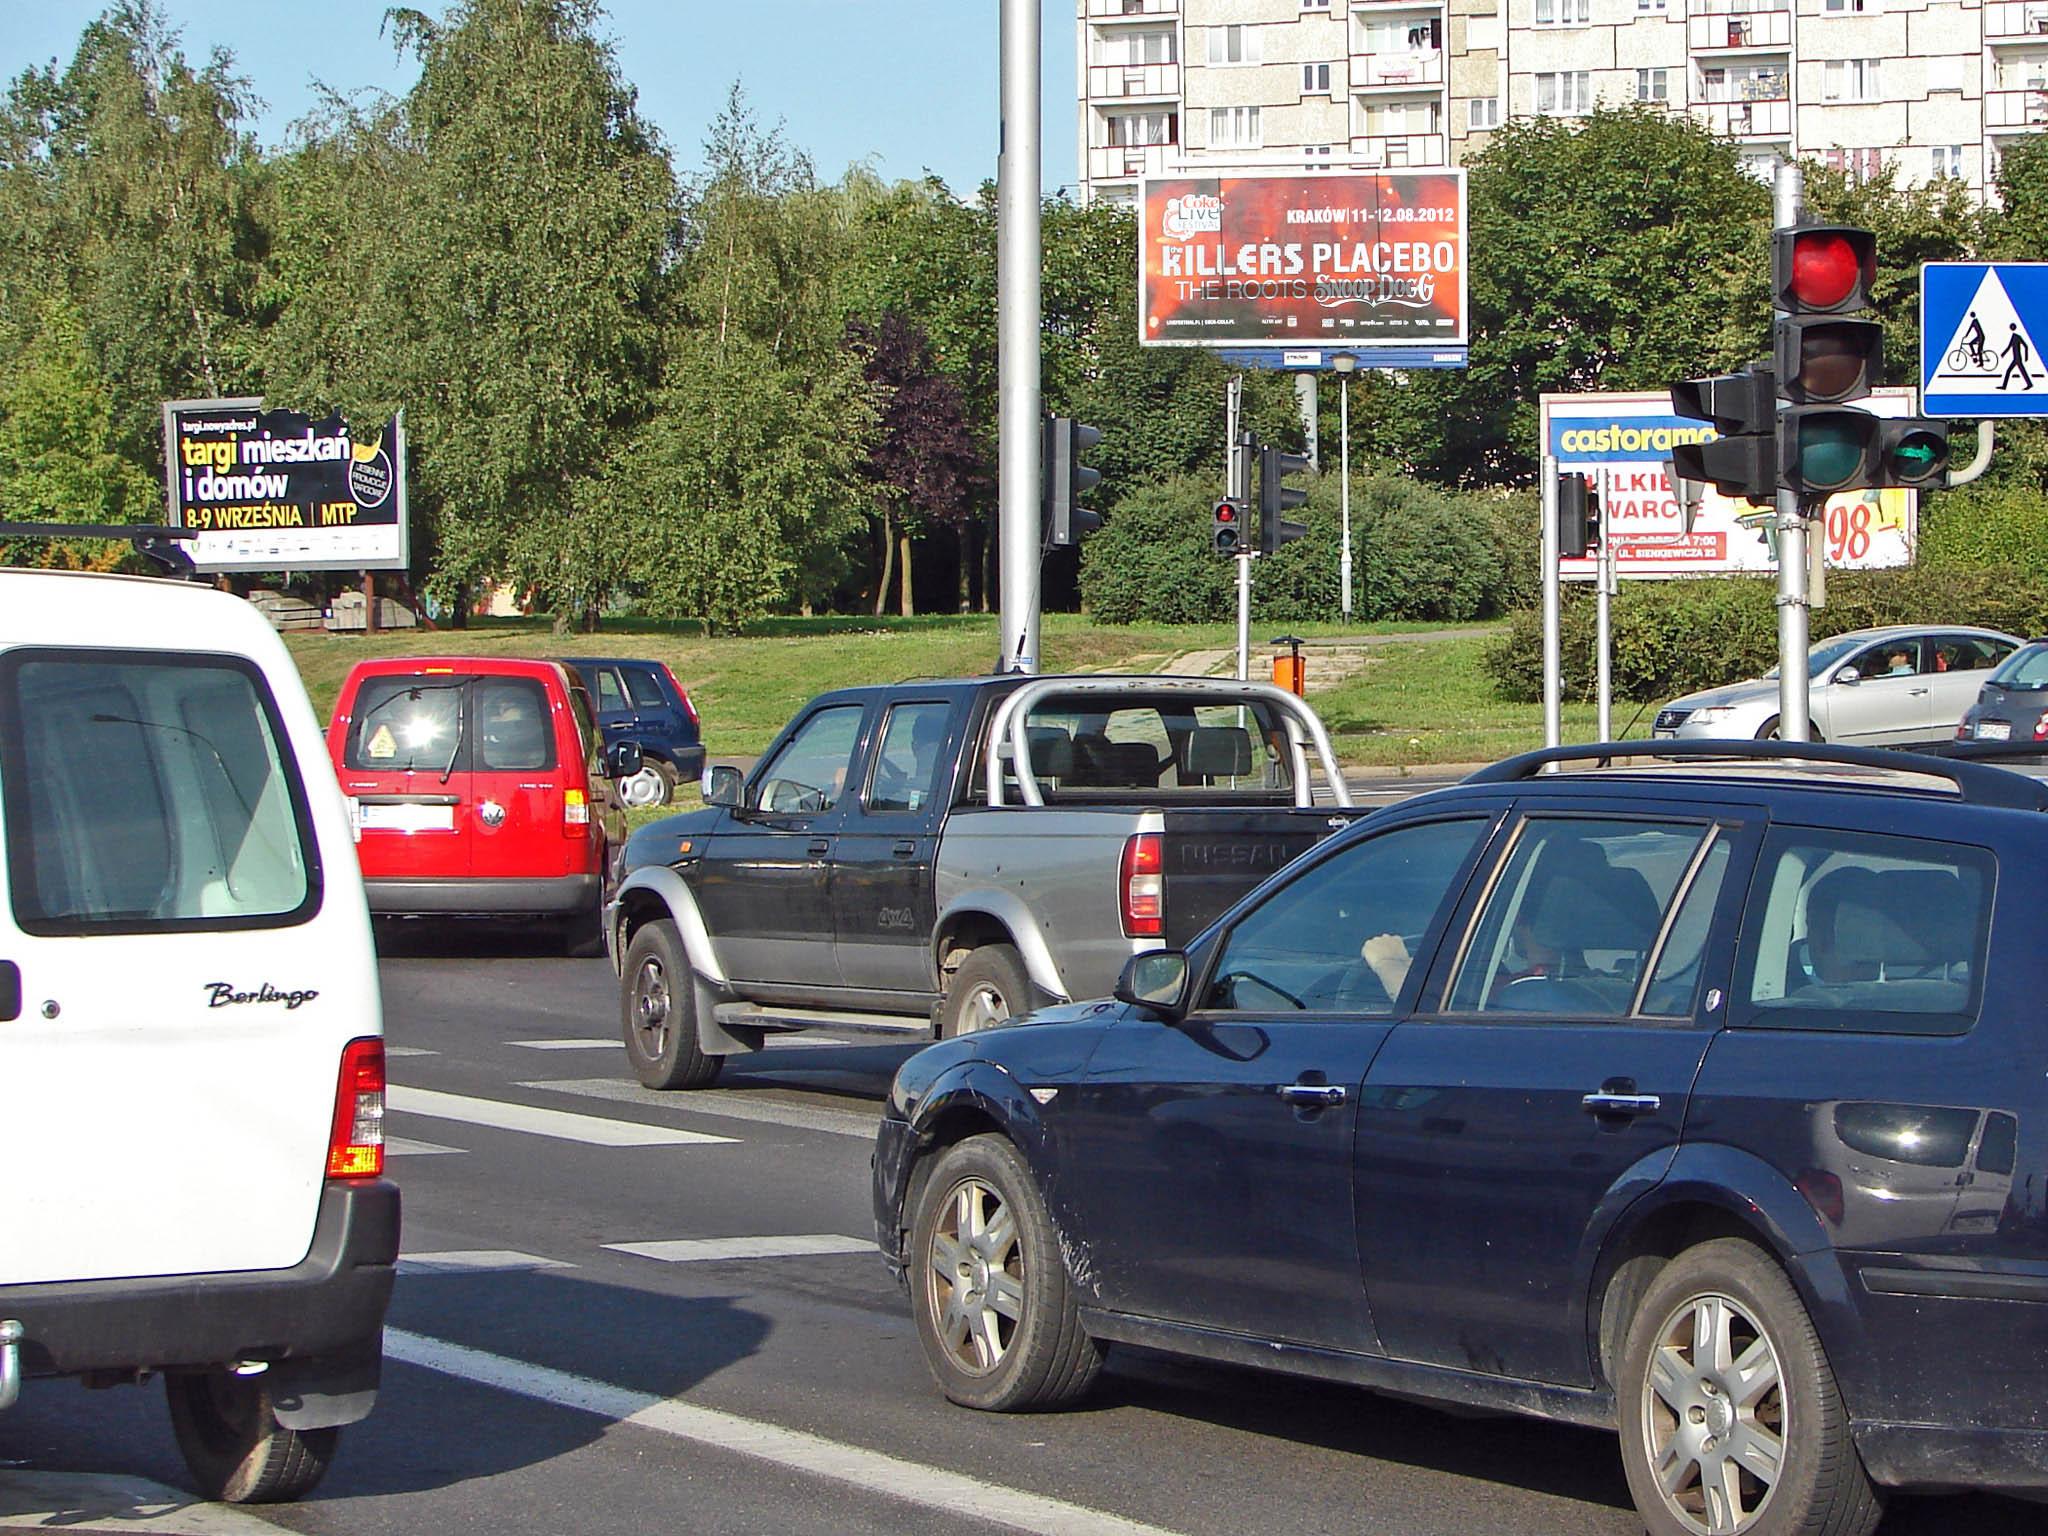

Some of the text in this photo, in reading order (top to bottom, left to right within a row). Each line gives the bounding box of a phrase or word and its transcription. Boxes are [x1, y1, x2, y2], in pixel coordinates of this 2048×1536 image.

[1179, 202, 1219, 220] Live
[1183, 196, 1219, 209] Coke
[1287, 206, 1454, 224] KRAKÓW 11-12.08.2012
[1162, 242, 1454, 276] KILLERS PLACEBO
[1175, 280, 1308, 300] THE ROOTS
[182, 427, 350, 474] targi mieszkań
[185, 465, 289, 501] i domów
[186, 501, 358, 529] 8-9 WRZEŚNIA MTP
[1693, 536, 1717, 546] 7:00
[203, 982, 319, 1010] Berlingo
